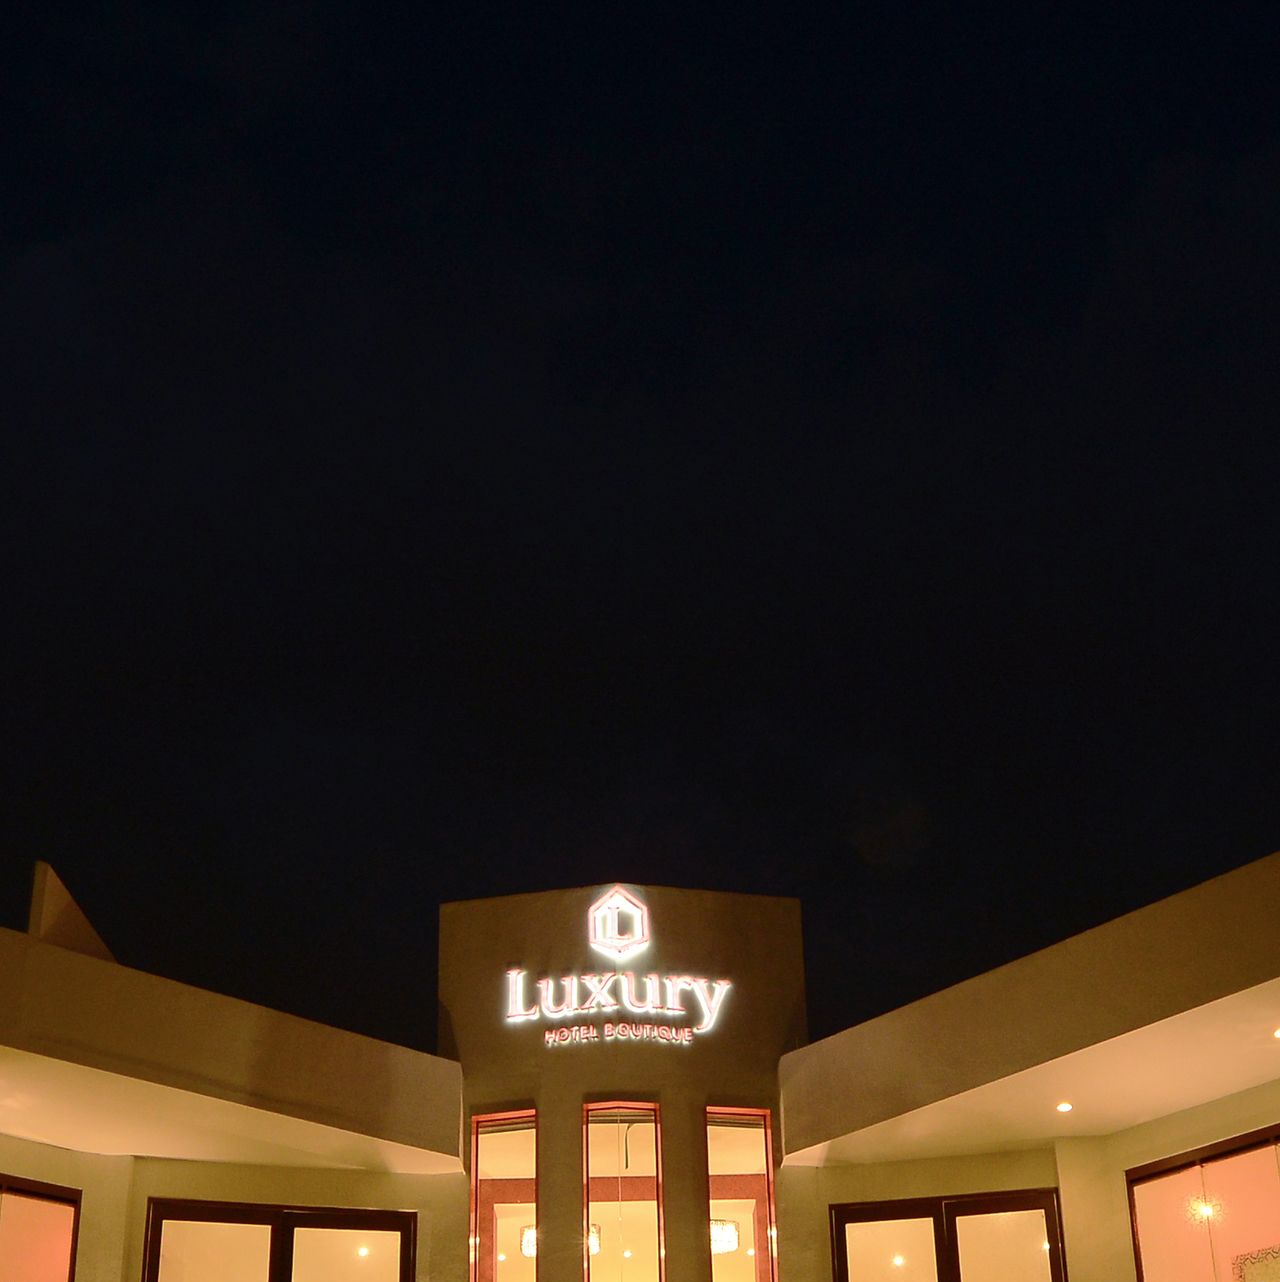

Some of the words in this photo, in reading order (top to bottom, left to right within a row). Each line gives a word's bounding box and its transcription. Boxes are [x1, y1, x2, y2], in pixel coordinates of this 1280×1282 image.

[506, 968, 732, 1034] Luxury
[544, 1025, 599, 1045] HOTEL
[604, 1023, 694, 1044] BOUTIQUE
